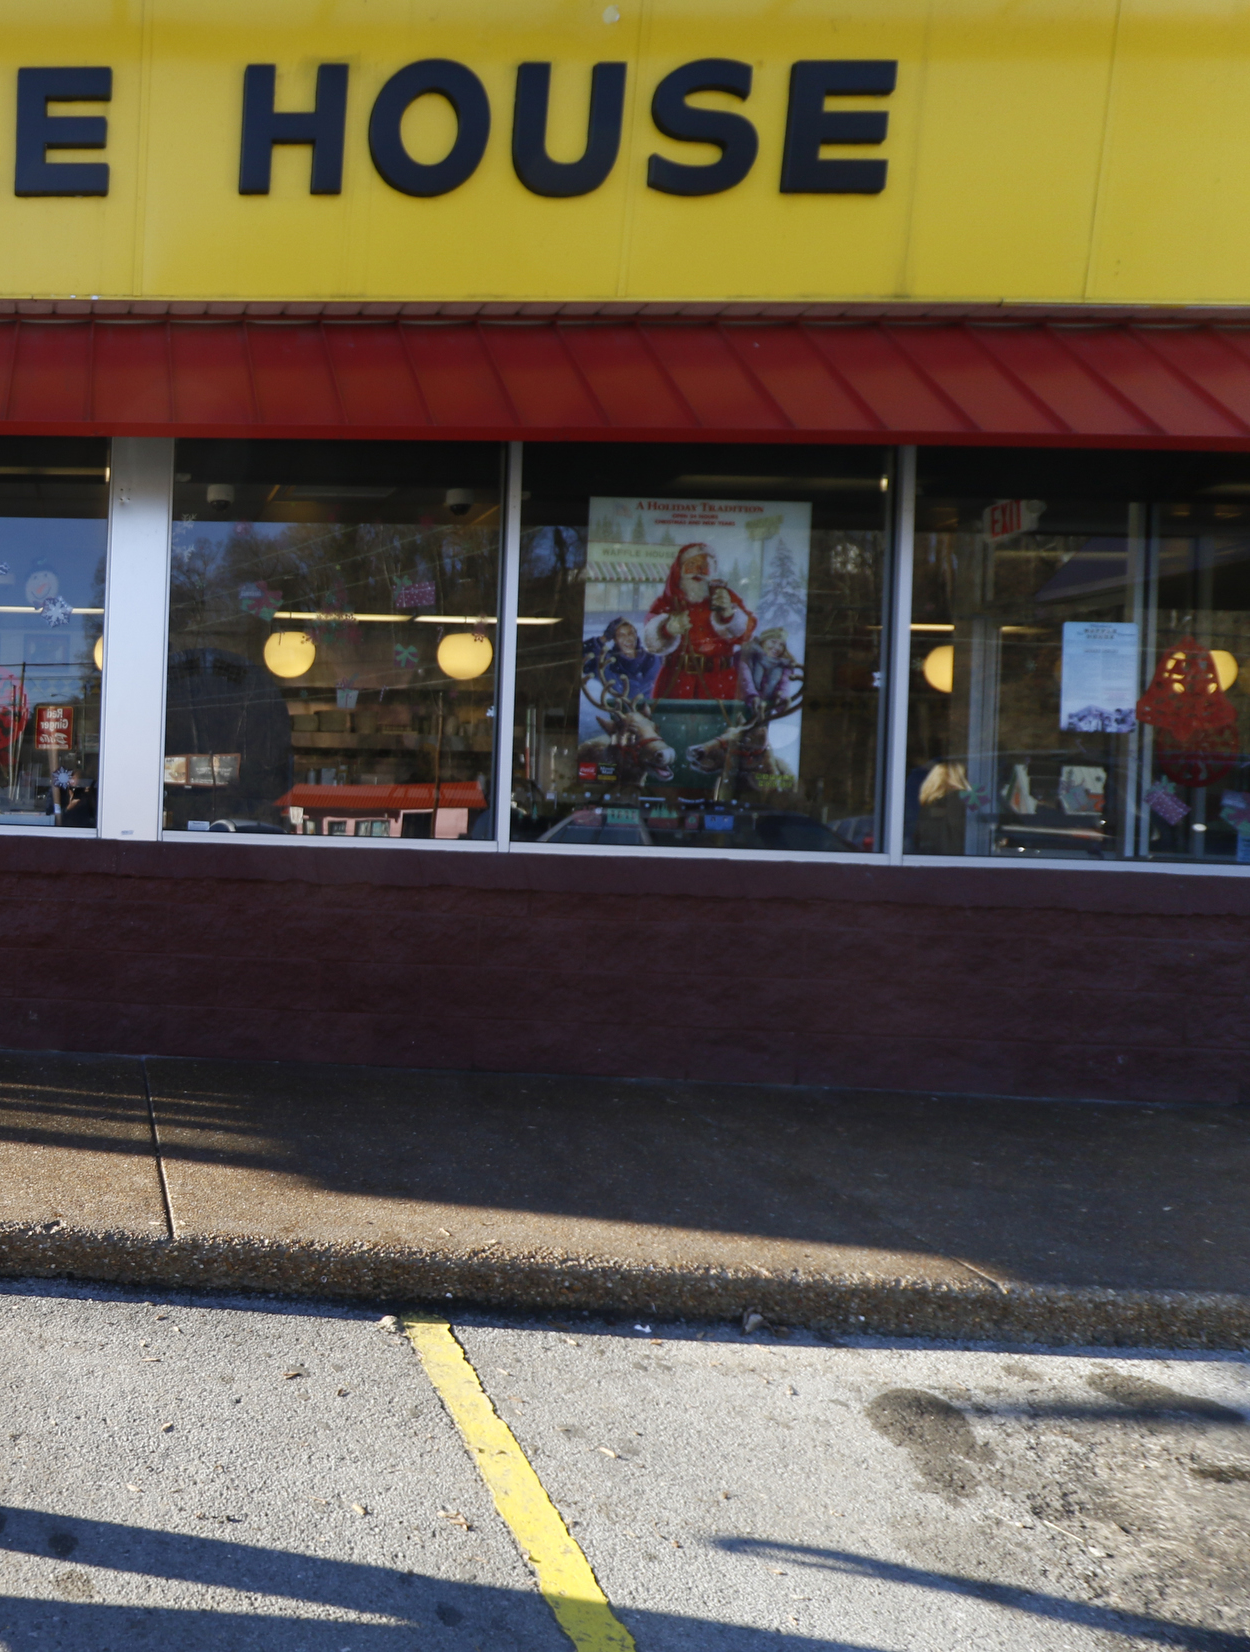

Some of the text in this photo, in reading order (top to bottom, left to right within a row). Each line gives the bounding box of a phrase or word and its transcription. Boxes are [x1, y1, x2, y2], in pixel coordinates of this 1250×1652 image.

[239, 57, 898, 198] HOUSE
[636, 501, 766, 513] A HOLIDAY TRADITION
[991, 500, 1021, 538] EXIT
[602, 549, 641, 558] WAFFLE
